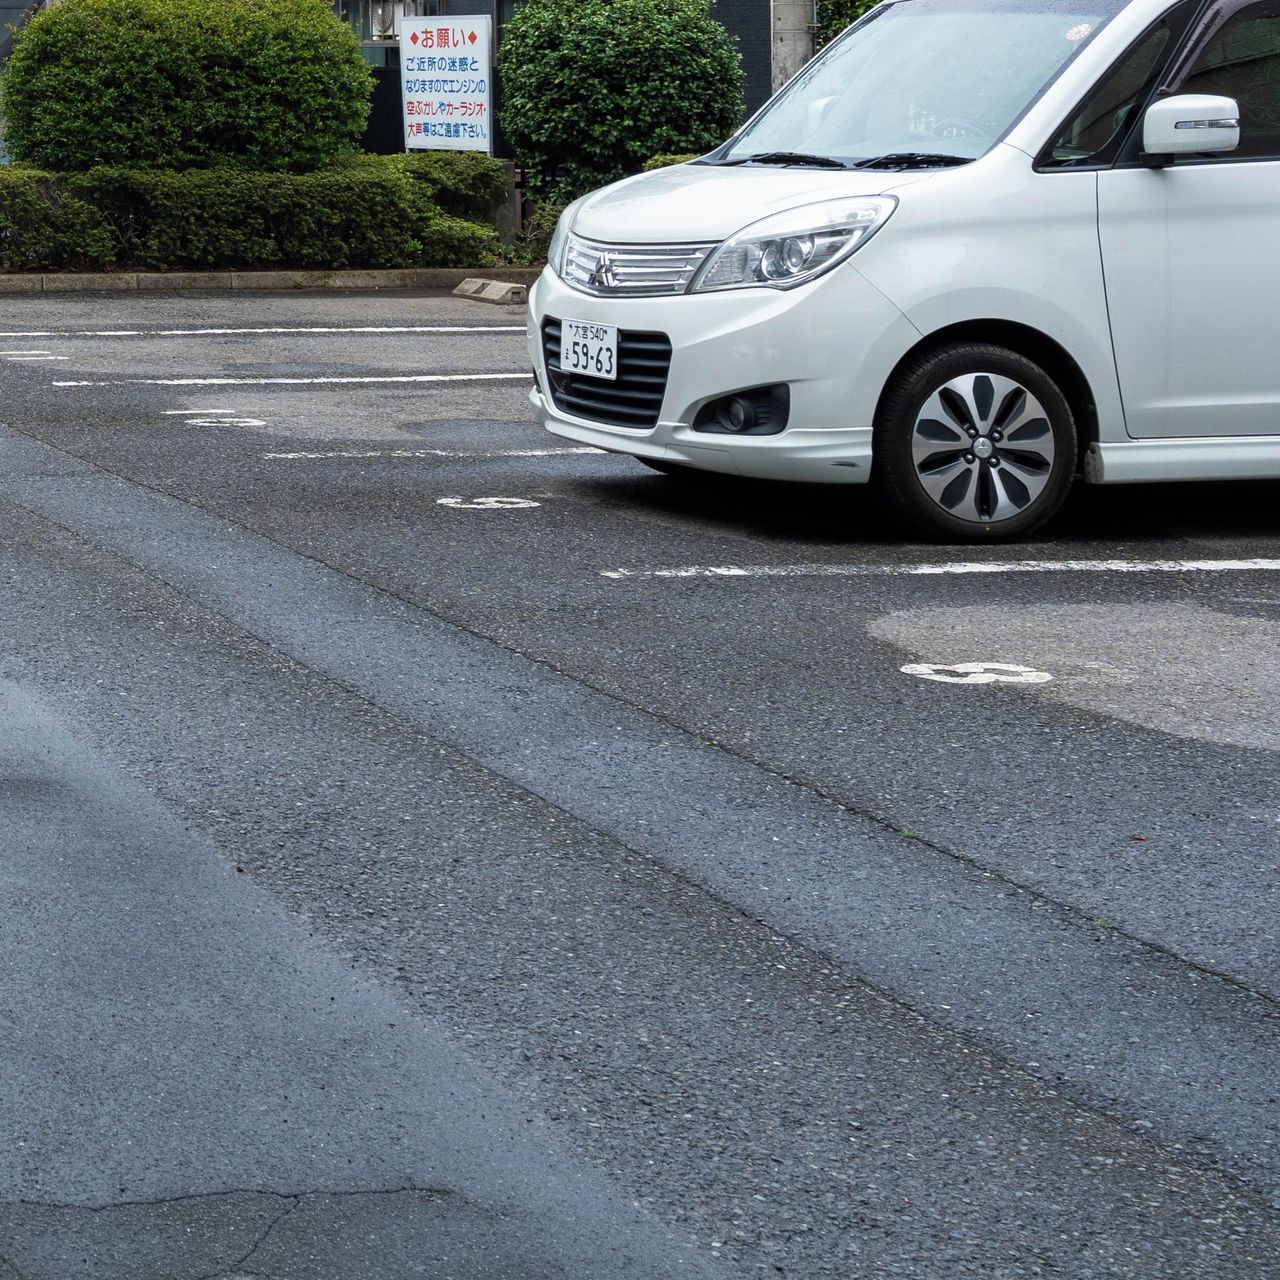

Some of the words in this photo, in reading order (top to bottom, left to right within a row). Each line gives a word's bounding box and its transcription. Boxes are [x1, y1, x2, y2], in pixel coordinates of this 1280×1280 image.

[421, 28, 466, 48] お願い
[406, 57, 479, 72] ご近所の迷惑と
[406, 79, 486, 93] なりますのでエンジンの
[407, 122, 487, 138] 大声等はご遠慮下さい。
[590, 326, 605, 341] 540
[572, 341, 613, 375] 59-63
